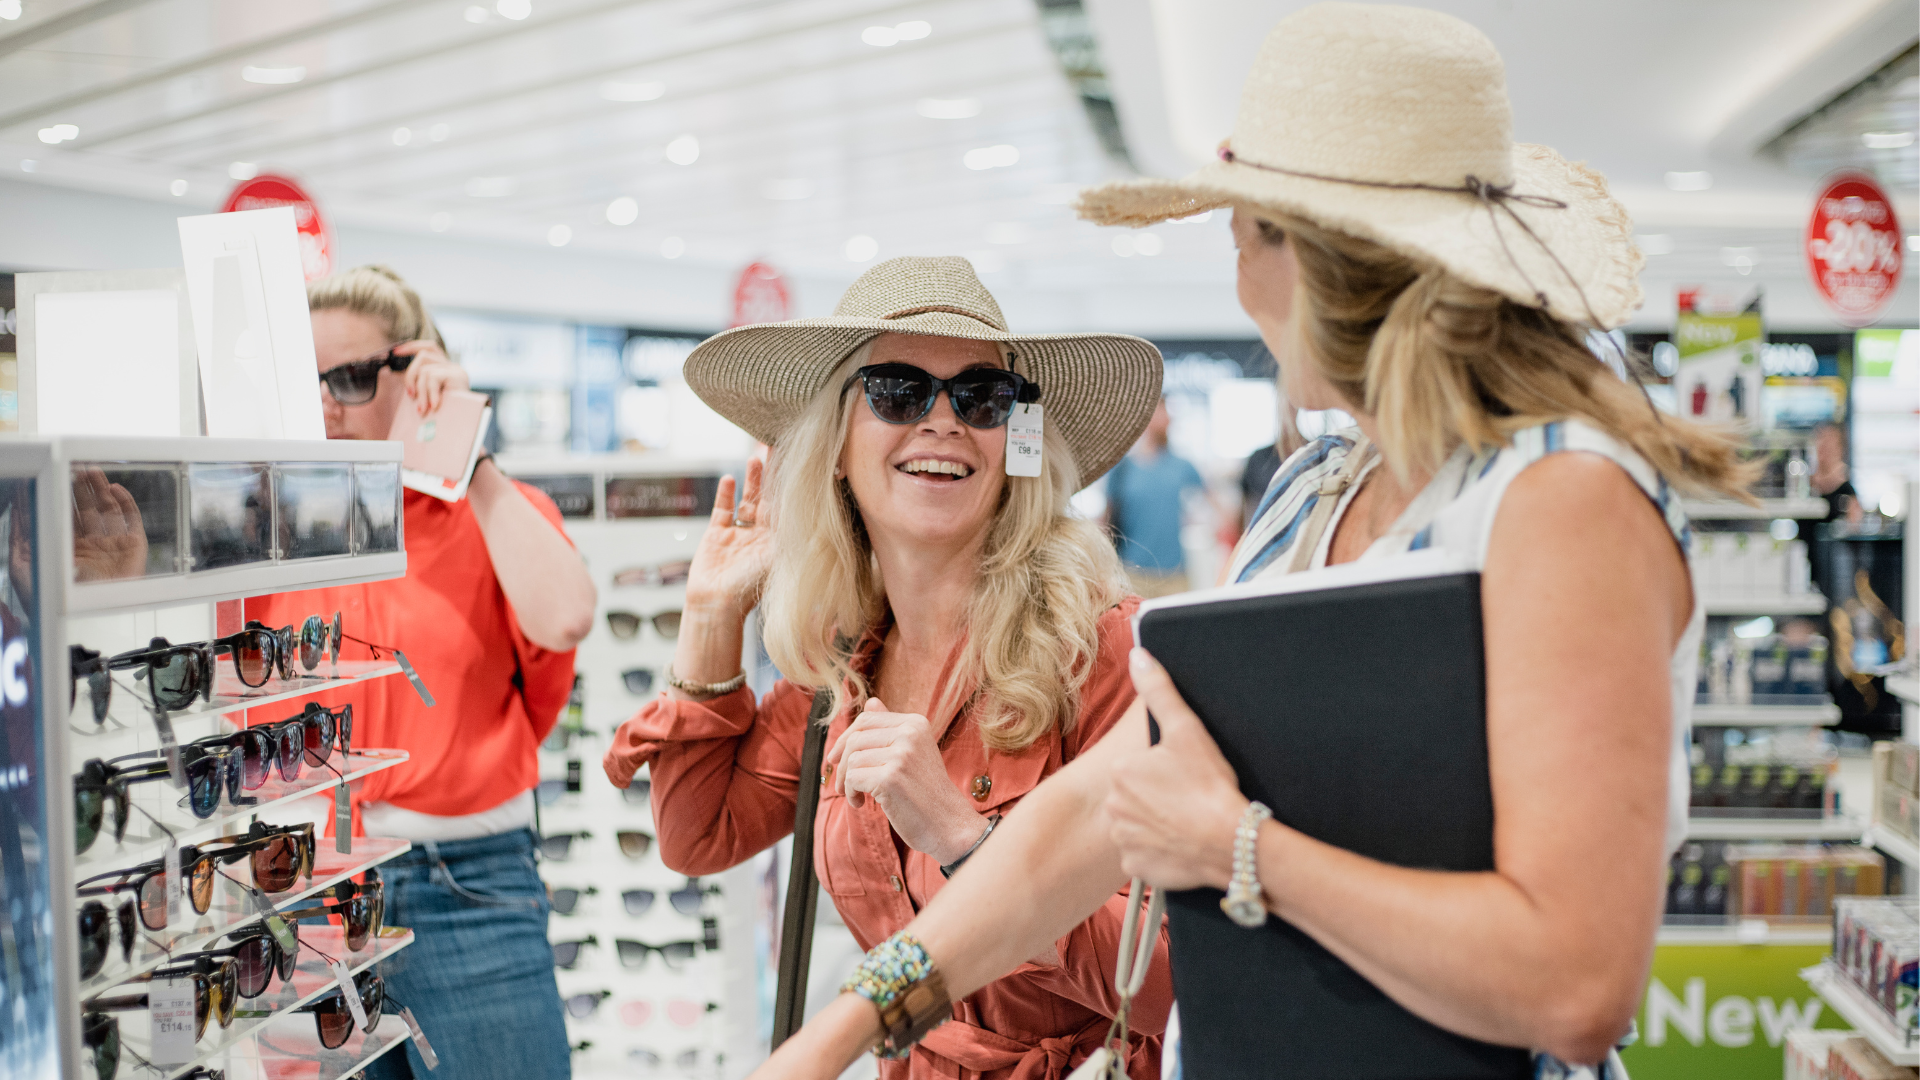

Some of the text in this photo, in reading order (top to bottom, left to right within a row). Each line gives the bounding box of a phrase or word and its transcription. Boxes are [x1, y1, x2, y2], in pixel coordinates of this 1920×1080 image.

[1812, 219, 1900, 273] -20%
[275, 927, 288, 939] New
[1643, 976, 1823, 1048] New
